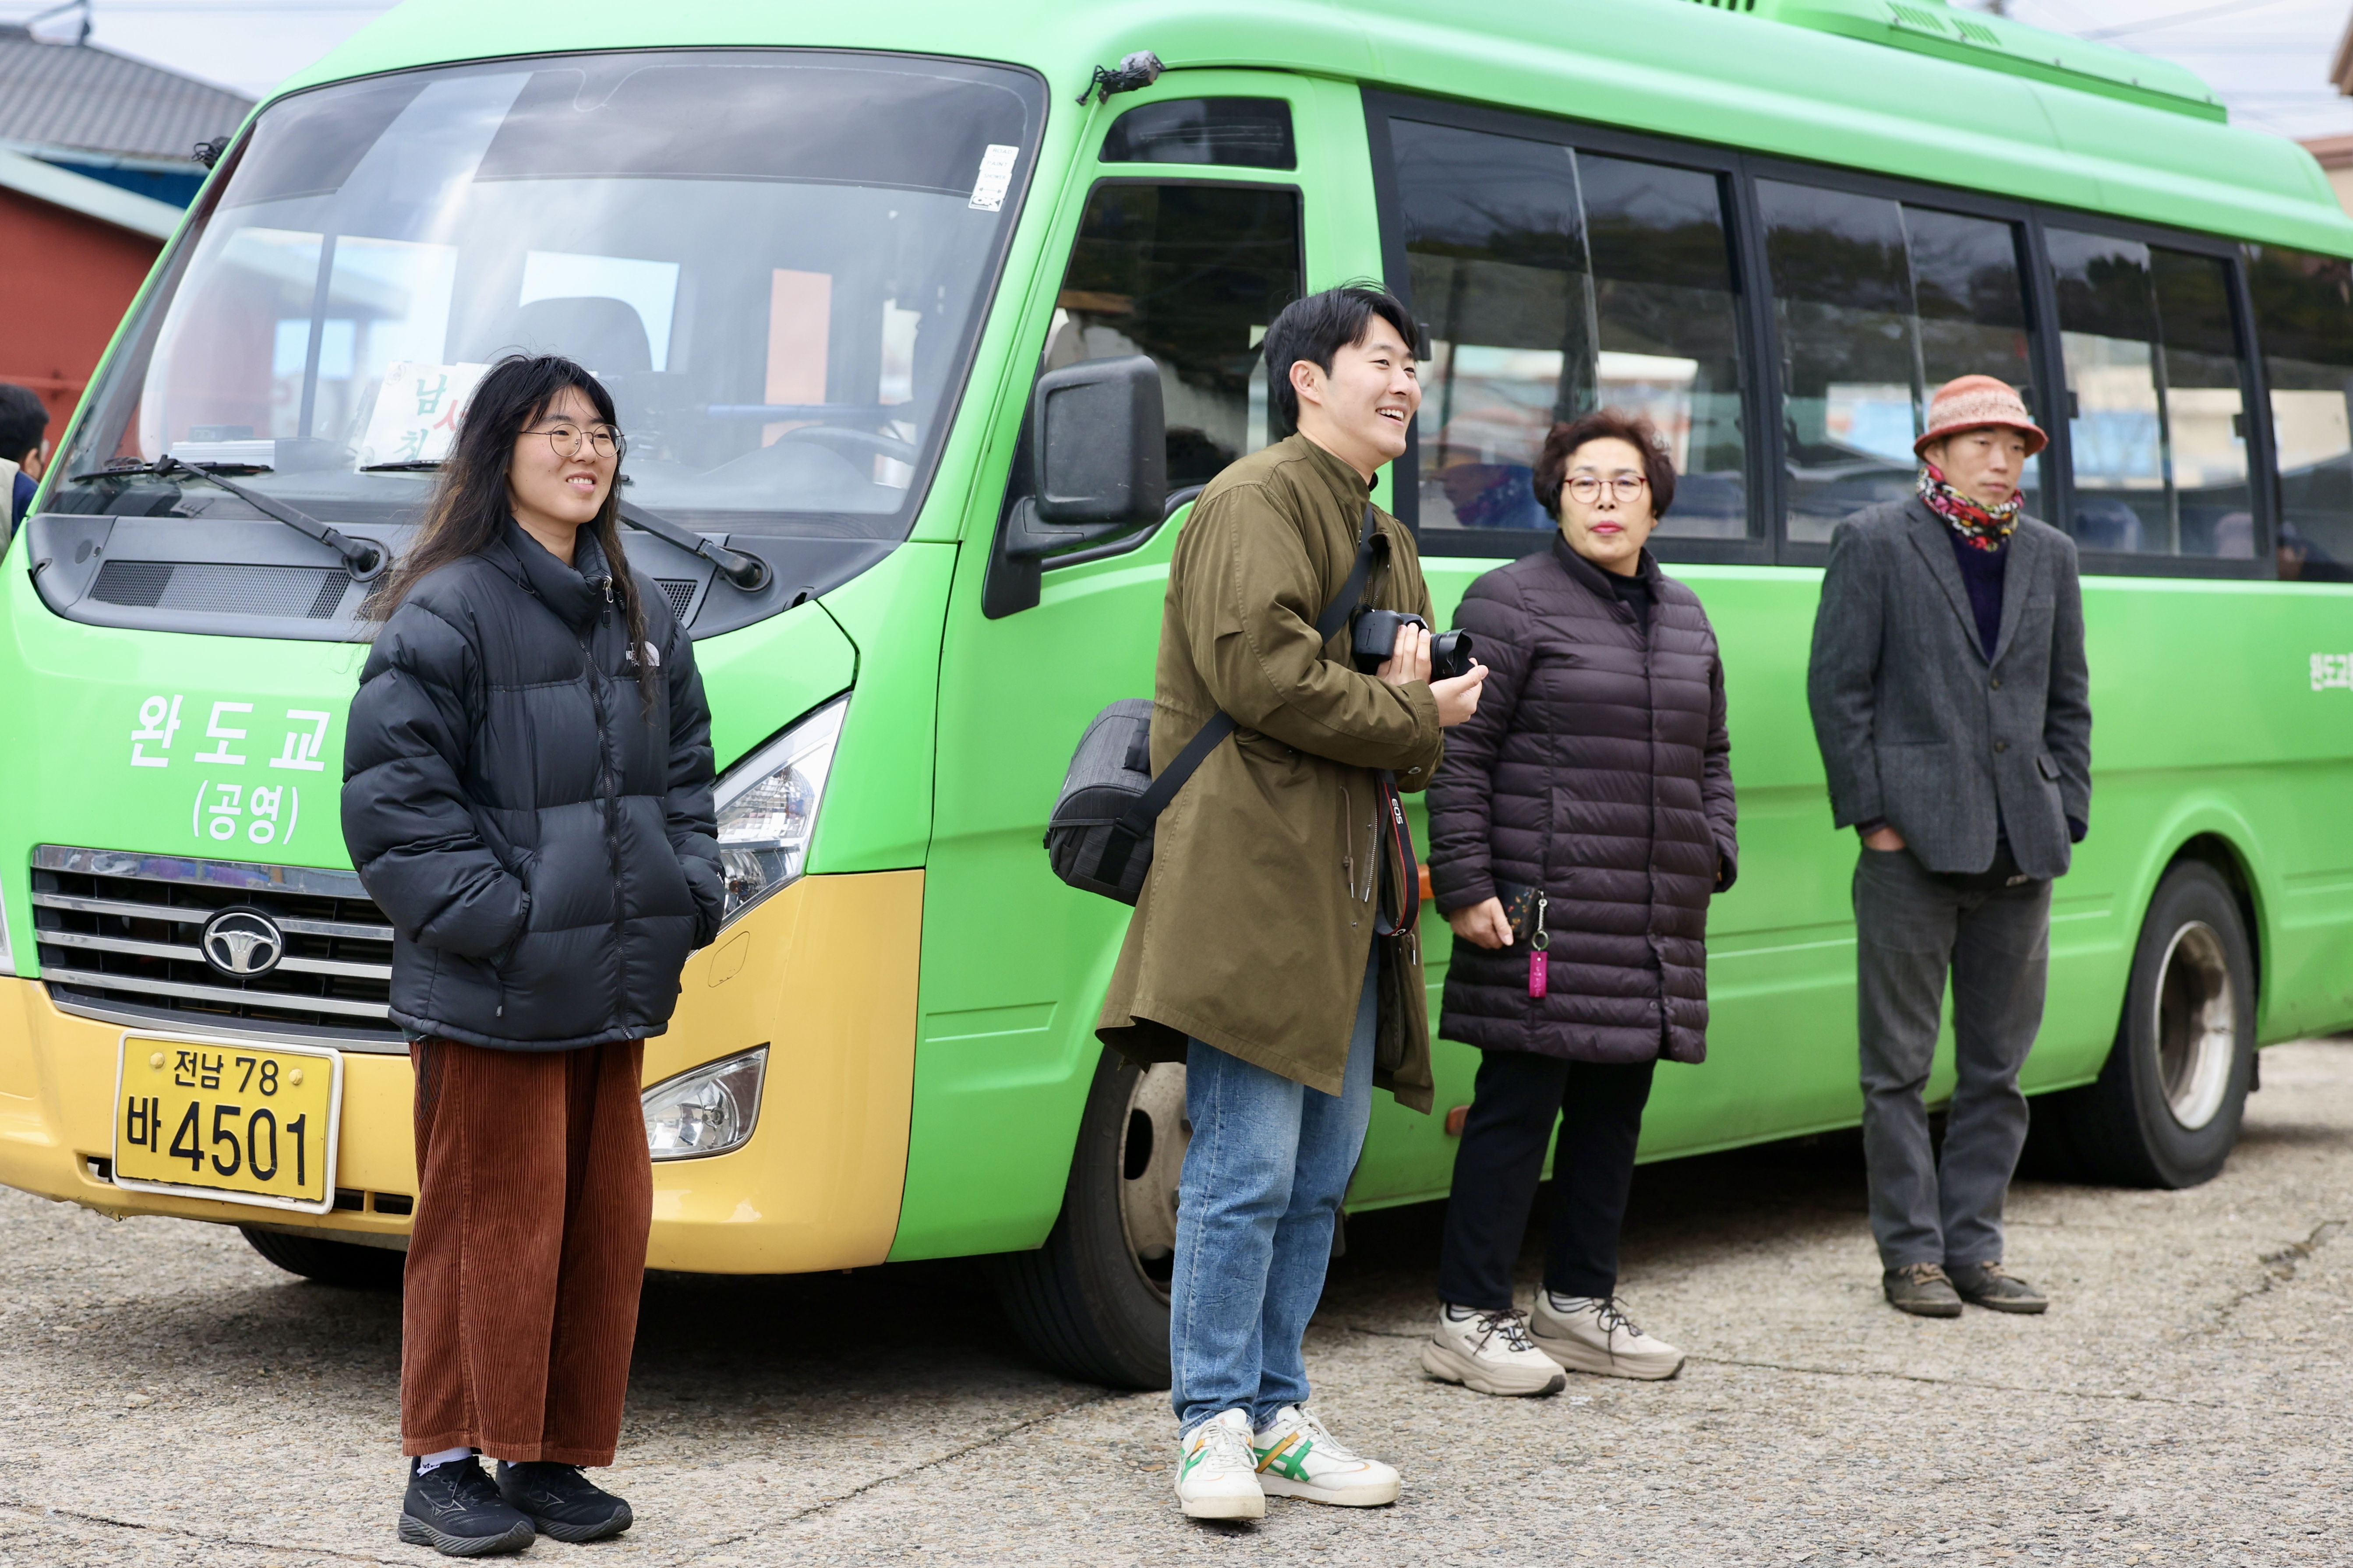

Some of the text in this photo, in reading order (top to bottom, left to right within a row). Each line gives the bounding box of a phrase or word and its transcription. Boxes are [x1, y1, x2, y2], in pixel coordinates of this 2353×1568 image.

[193, 780, 299, 845] (공영)
[1392, 798, 1403, 825] EOS
[174, 1050, 279, 1096] 전남 78
